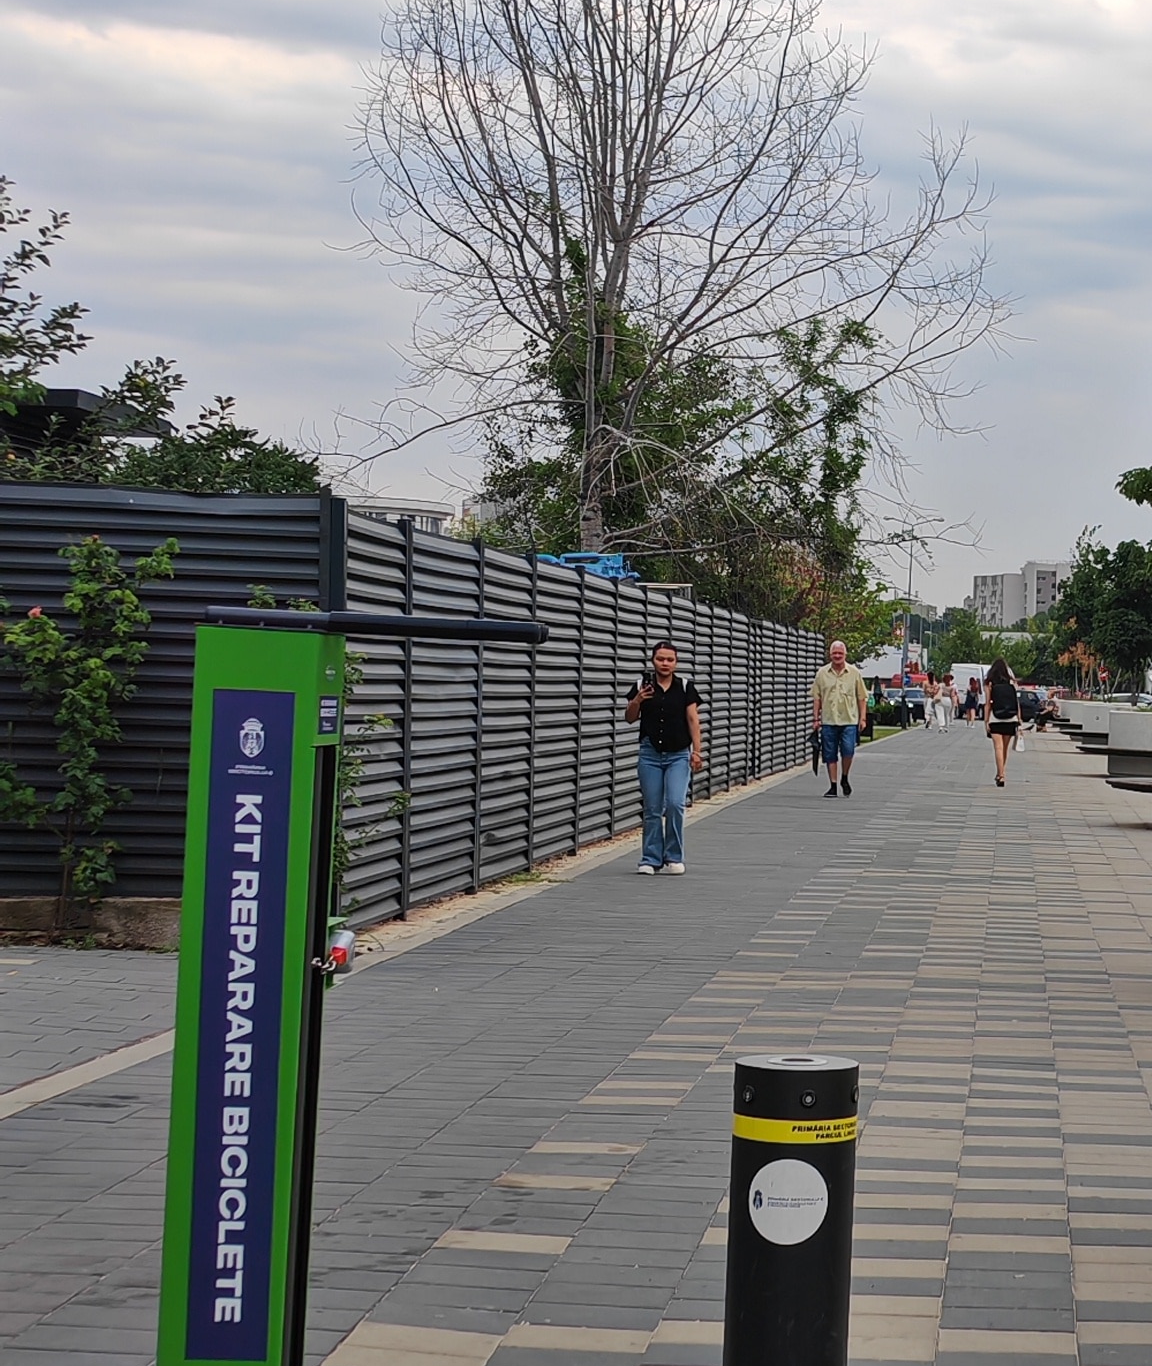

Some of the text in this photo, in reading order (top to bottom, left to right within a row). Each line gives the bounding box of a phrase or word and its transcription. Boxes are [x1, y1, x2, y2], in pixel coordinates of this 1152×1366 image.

[233, 794, 263, 862] KIT
[223, 870, 260, 1097] REPARARE
[214, 1106, 250, 1323] BICICLETE
